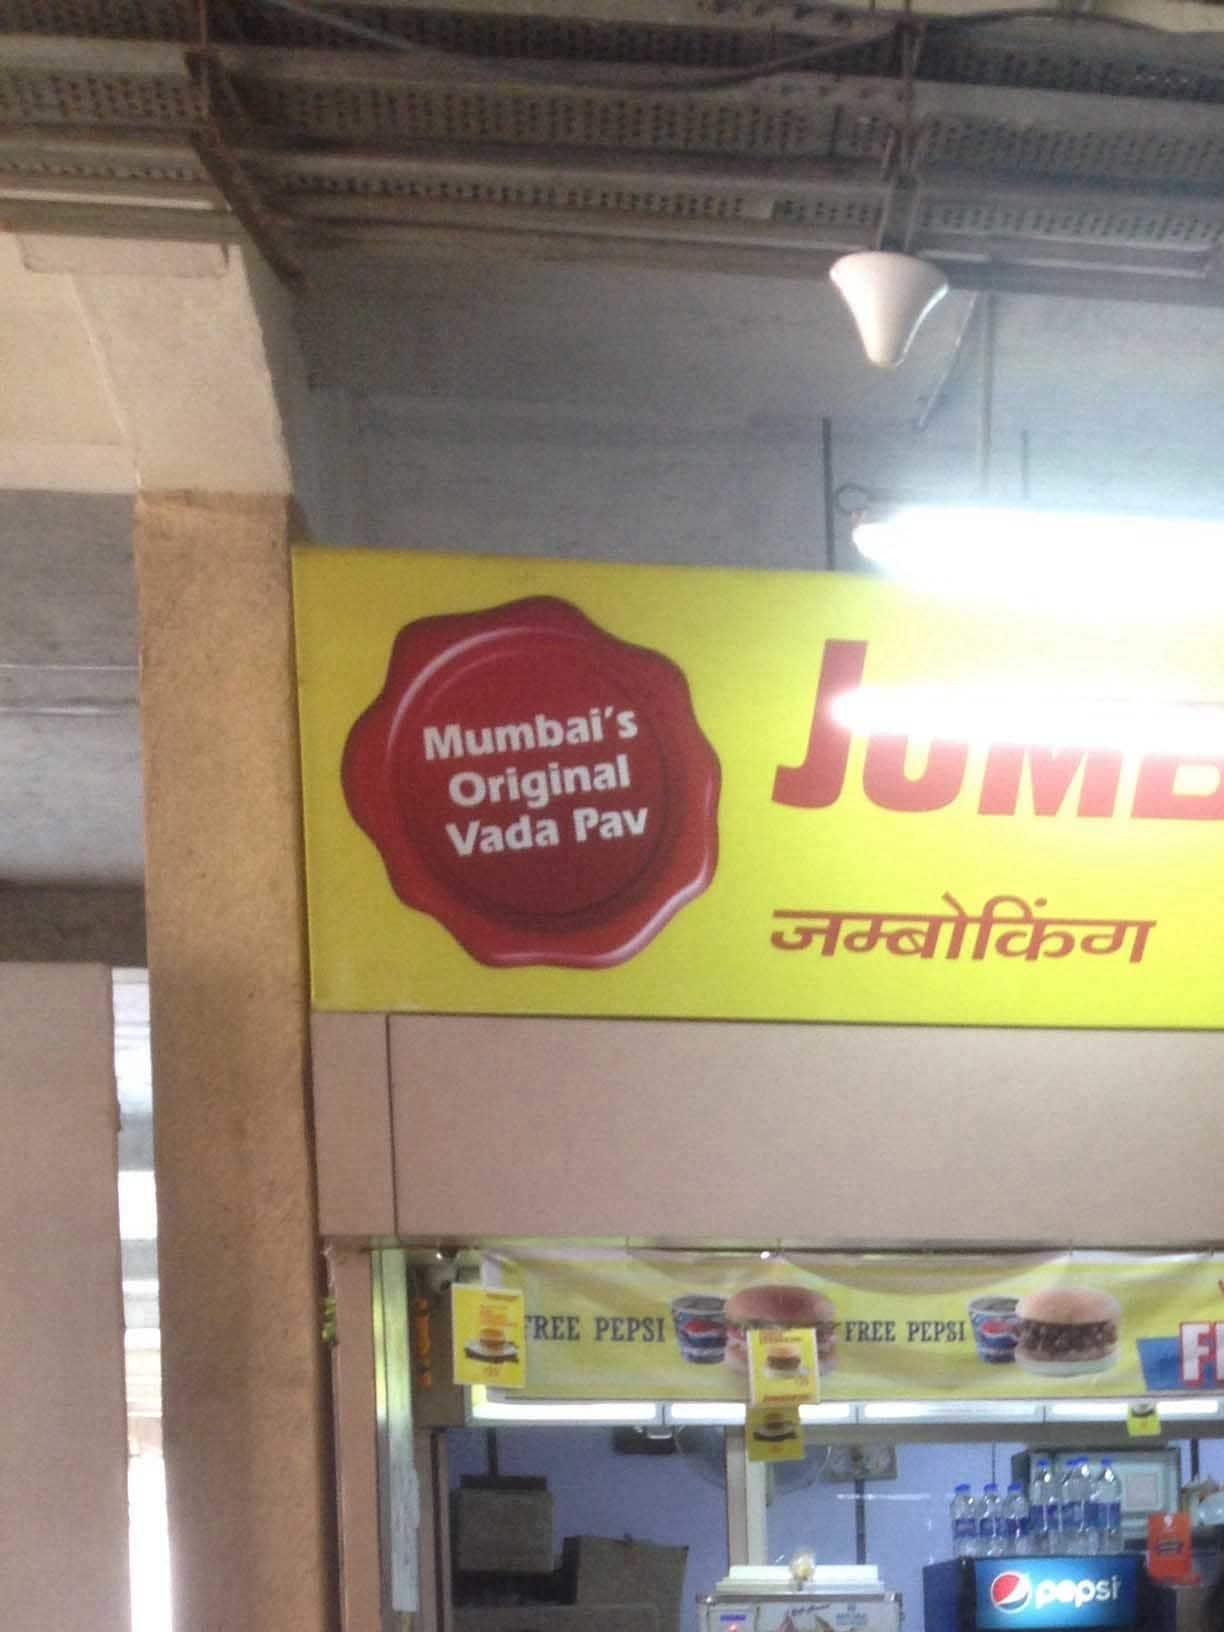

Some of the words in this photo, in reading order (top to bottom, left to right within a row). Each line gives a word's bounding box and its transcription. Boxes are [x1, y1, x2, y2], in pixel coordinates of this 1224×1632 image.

[423, 704, 638, 760] Mumbai's
[448, 754, 631, 809] Original
[446, 817, 560, 857] Vada
[574, 804, 649, 845] Pav
[771, 892, 1157, 963] जम्बोकिंग
[593, 1316, 665, 1342] PEPSI
[845, 1320, 896, 1342] FREE
[906, 1320, 967, 1343] PEPSI
[1035, 1574, 1121, 1610] pepsi
